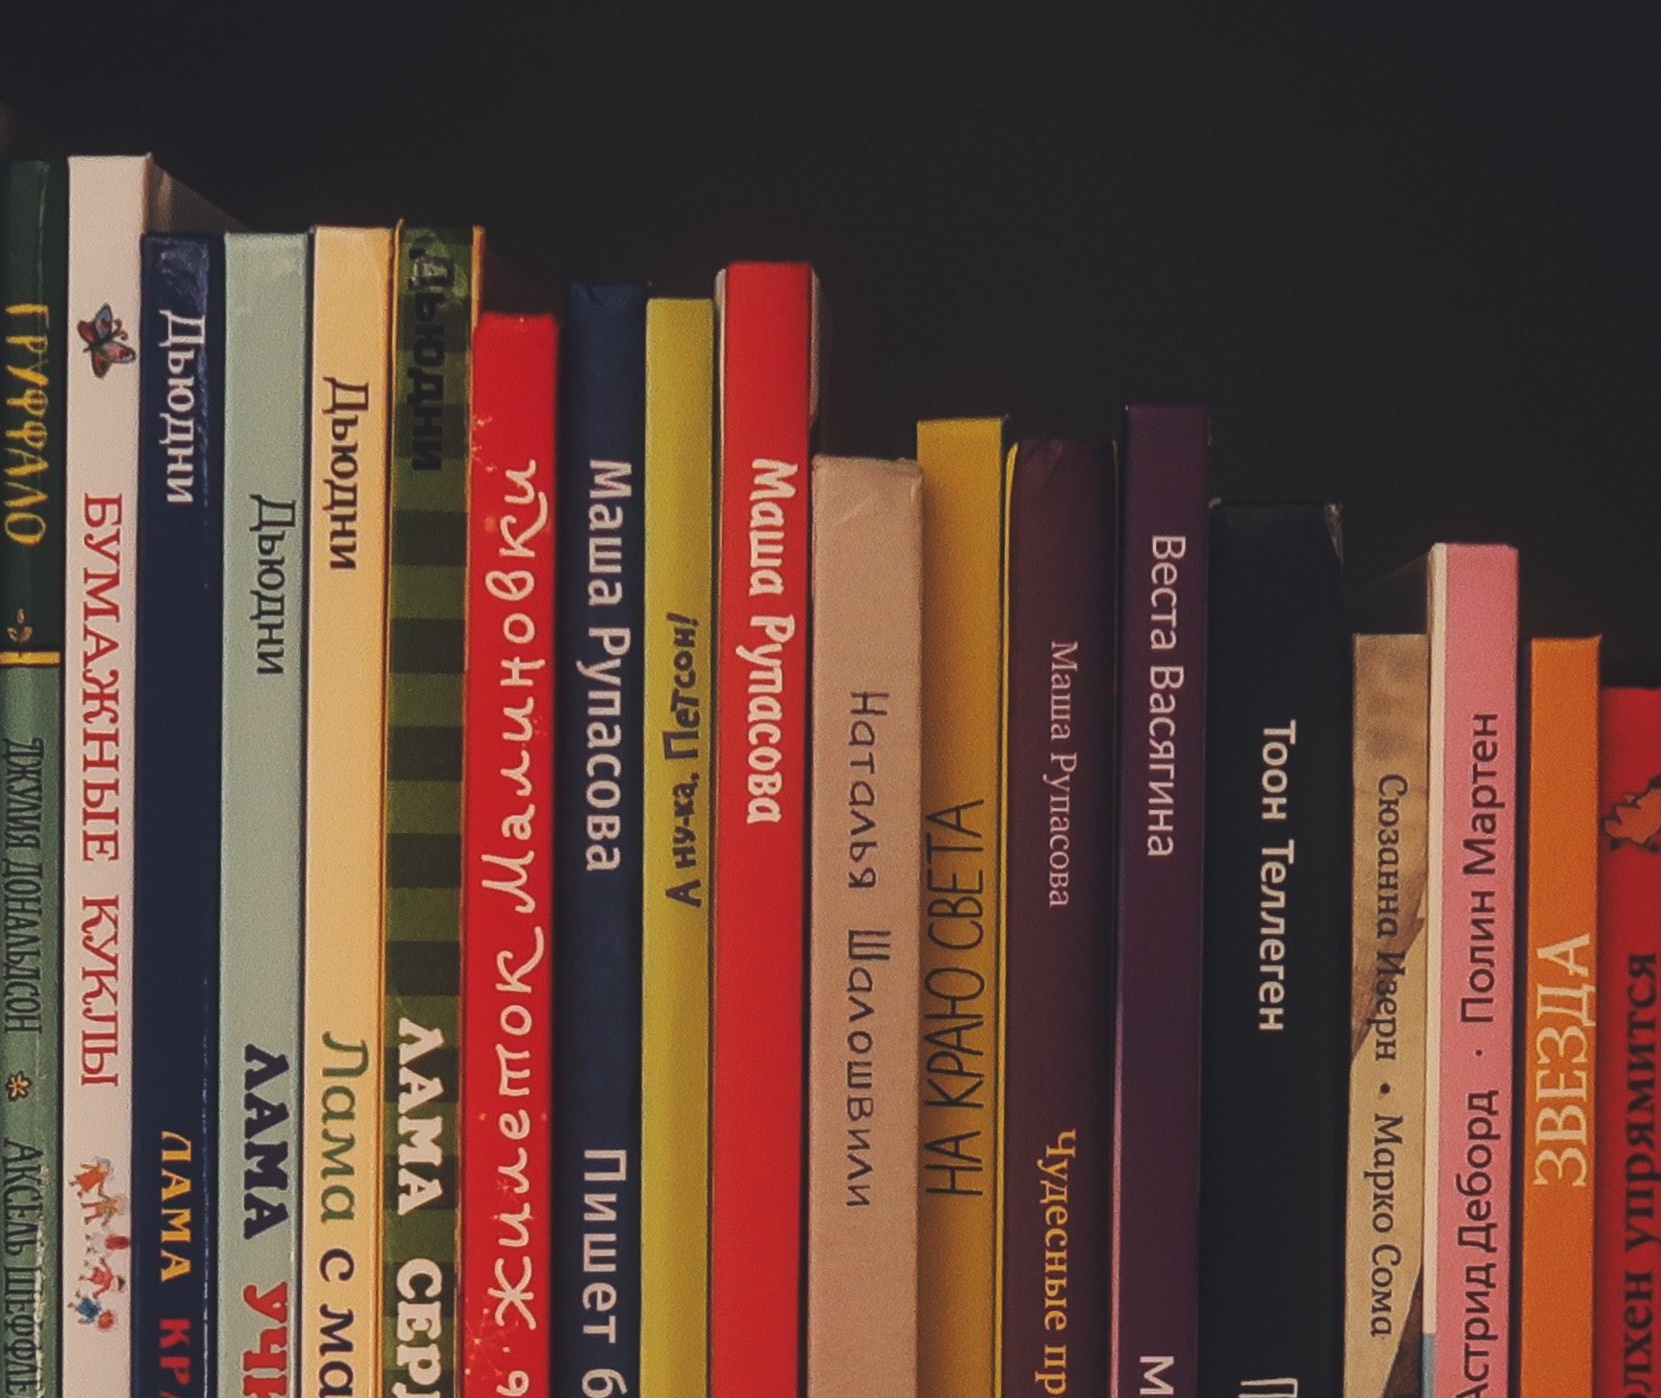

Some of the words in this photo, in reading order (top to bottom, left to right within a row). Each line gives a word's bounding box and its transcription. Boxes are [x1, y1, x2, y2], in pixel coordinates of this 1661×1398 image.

[6, 304, 48, 545] ГРУФФАЛО
[160, 310, 205, 502] Дьюдни
[250, 494, 296, 674] Дьюдни
[1150, 536, 1186, 650] Веста
[83, 494, 122, 861] БУМАЖНЫЕ
[663, 614, 700, 759] Петсон!
[1051, 641, 1078, 740] Маша
[848, 692, 889, 889] Наталья
[1043, 753, 1077, 906] Рупасова
[1147, 666, 1184, 856] Васягина
[1262, 719, 1296, 820] Тоон
[1462, 713, 1501, 875] Мартен
[666, 880, 701, 907] А
[921, 801, 983, 950] СВЕТА
[1259, 839, 1295, 1030] Теллеген
[1372, 774, 1409, 937] Сюзанна
[81, 896, 119, 1086] КУКЛЫ
[921, 968, 983, 1107] КРАЮ
[1370, 949, 1407, 1062] Изерн
[1461, 891, 1495, 1023] Полин
[321, 1032, 369, 1223] Лама
[398, 1018, 443, 1215] ЛАМА
[846, 930, 891, 1206] Шалошвили
[1534, 934, 1594, 1186] ЗВЕЗДА
[161, 1131, 191, 1281] ЛАМА
[244, 1045, 289, 1239] ЛАМА
[920, 1132, 981, 1195] НА
[1364, 1114, 1403, 1233] Марко
[1456, 1090, 1501, 1253] Деборд
[320, 1249, 354, 1281] с
[582, 1150, 627, 1343] Пишет
[1037, 1130, 1076, 1330] Чудесные
[1371, 1244, 1401, 1337] Сома
